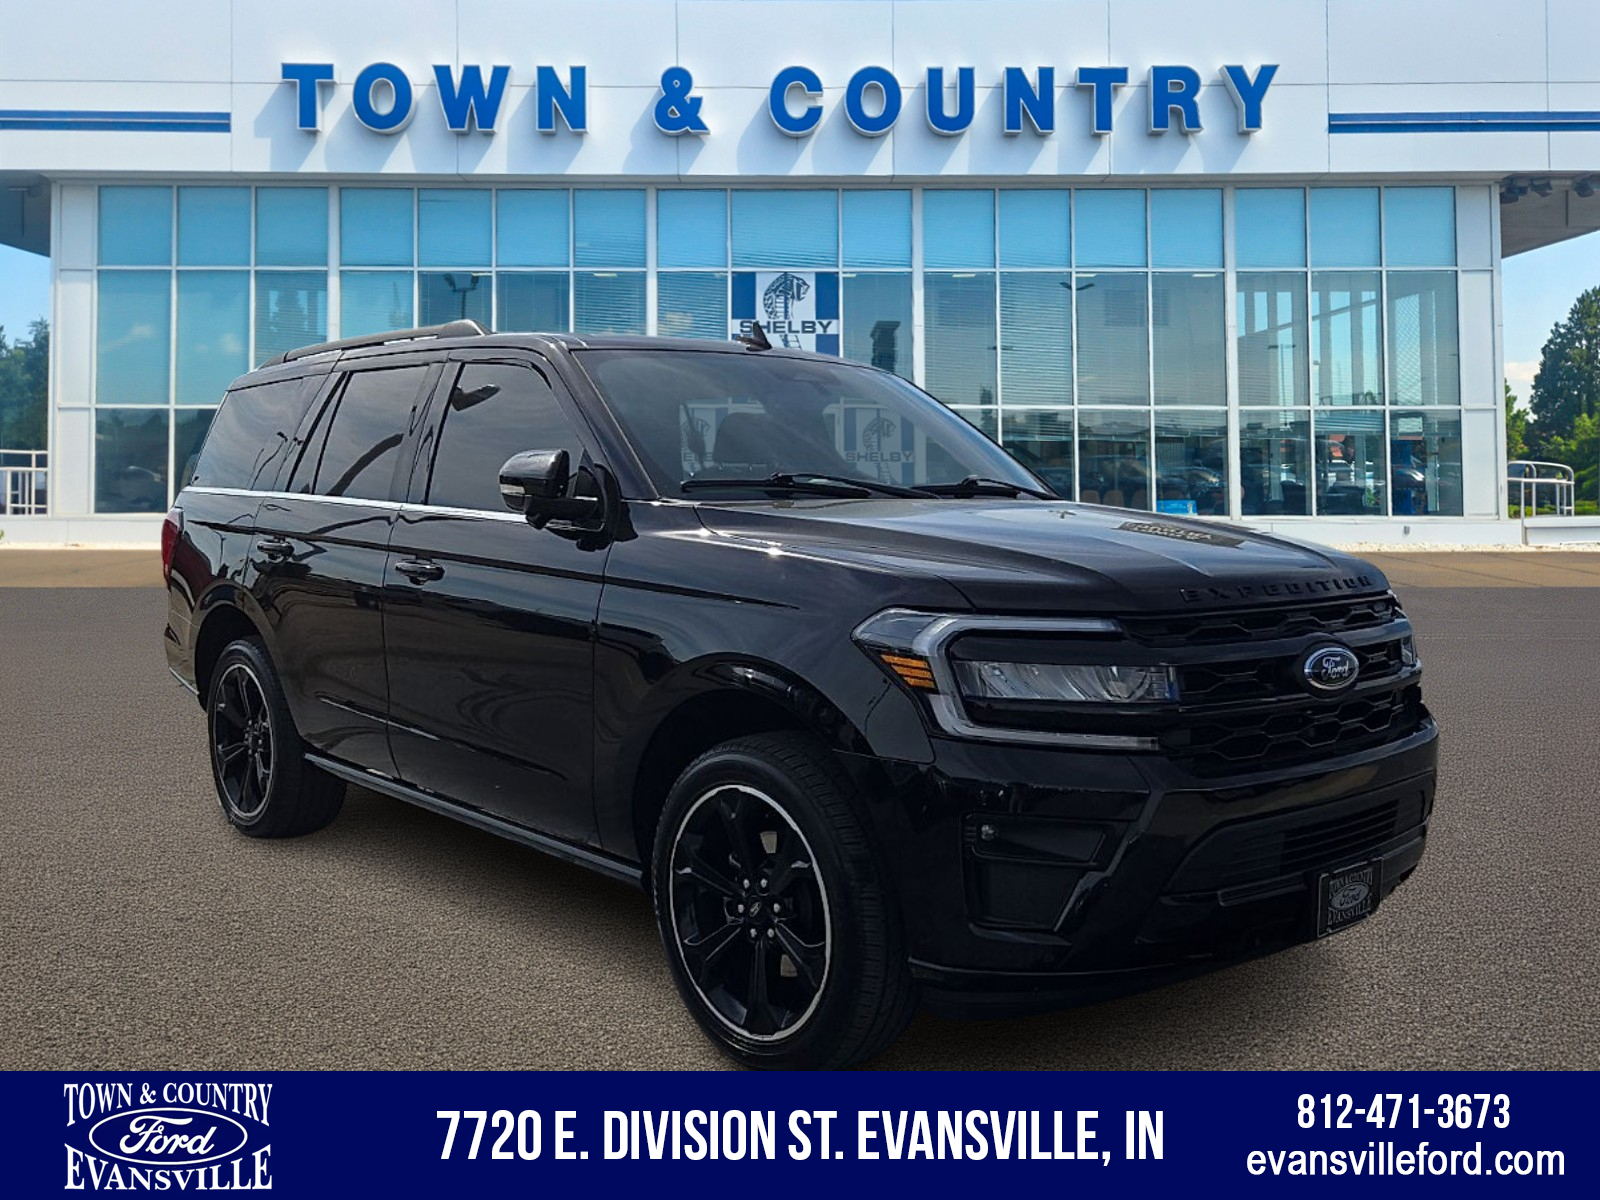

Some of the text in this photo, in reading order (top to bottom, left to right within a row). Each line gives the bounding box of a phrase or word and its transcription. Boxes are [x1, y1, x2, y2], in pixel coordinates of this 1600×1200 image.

[281, 62, 1281, 137] TOWN & COUNTRY
[740, 320, 832, 334] SHELBY
[845, 451, 913, 462] SHELBY
[1179, 575, 1373, 601] EXPEDITION
[1321, 656, 1349, 680] Ford
